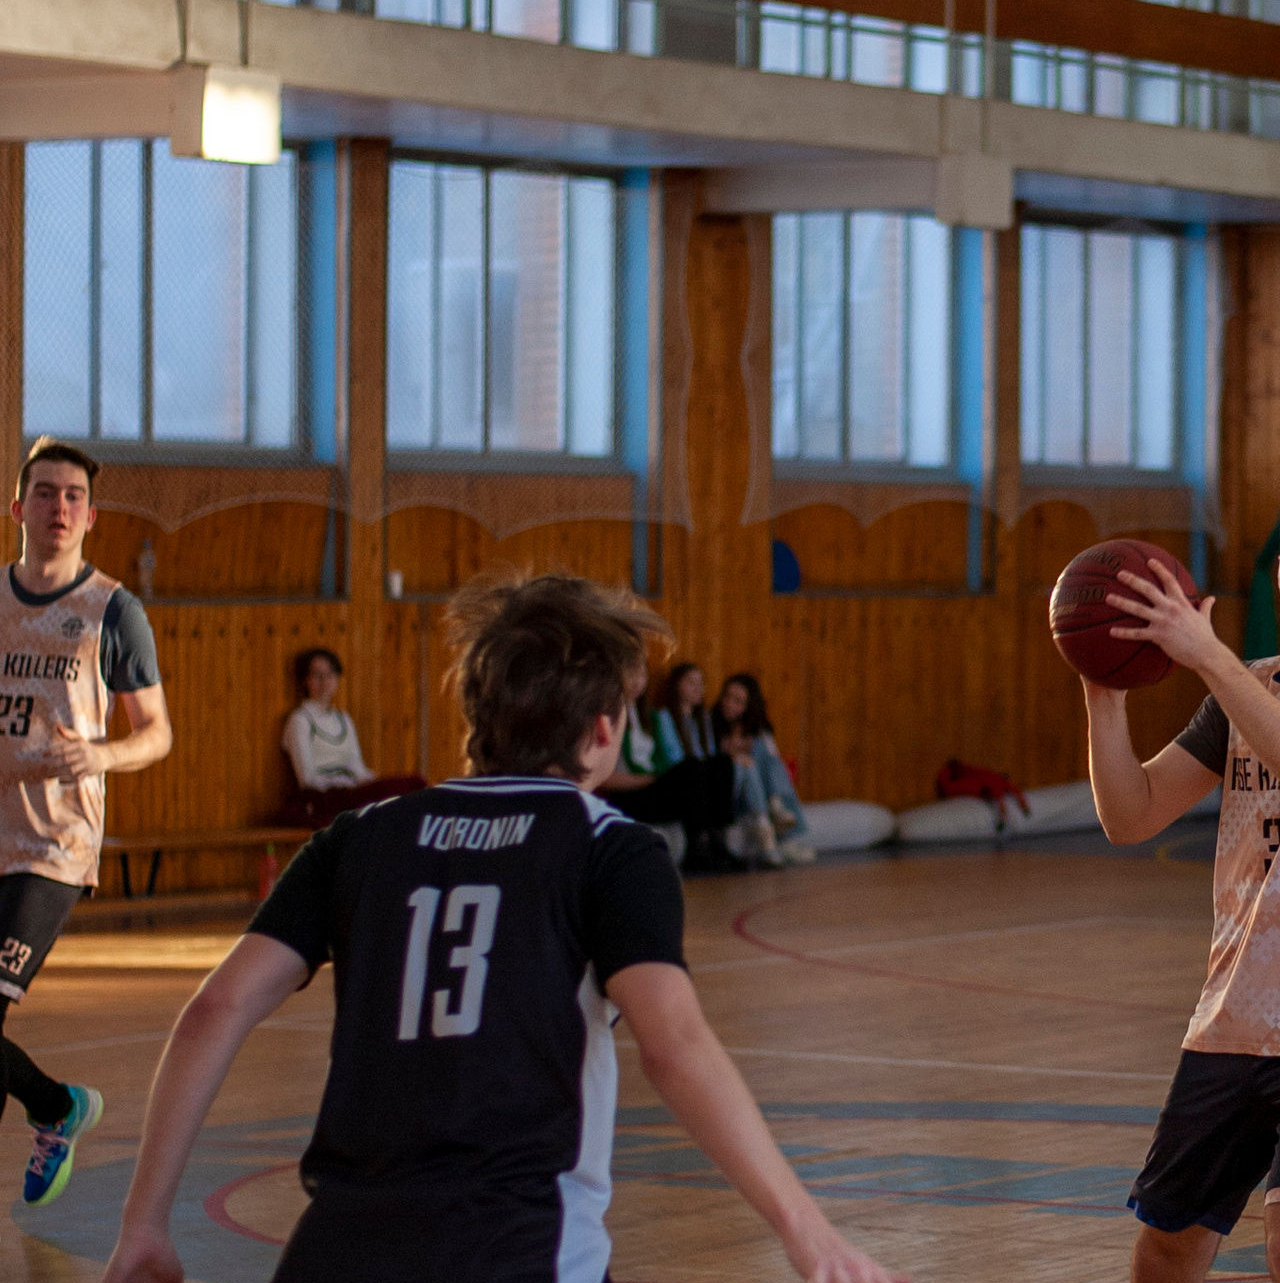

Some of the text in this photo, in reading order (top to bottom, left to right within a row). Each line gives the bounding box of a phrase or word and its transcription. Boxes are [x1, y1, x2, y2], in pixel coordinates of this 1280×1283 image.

[4, 652, 81, 682] KILLERS
[417, 813, 537, 851] VORONIN
[0, 936, 33, 976] 23
[397, 884, 501, 1041] 13
